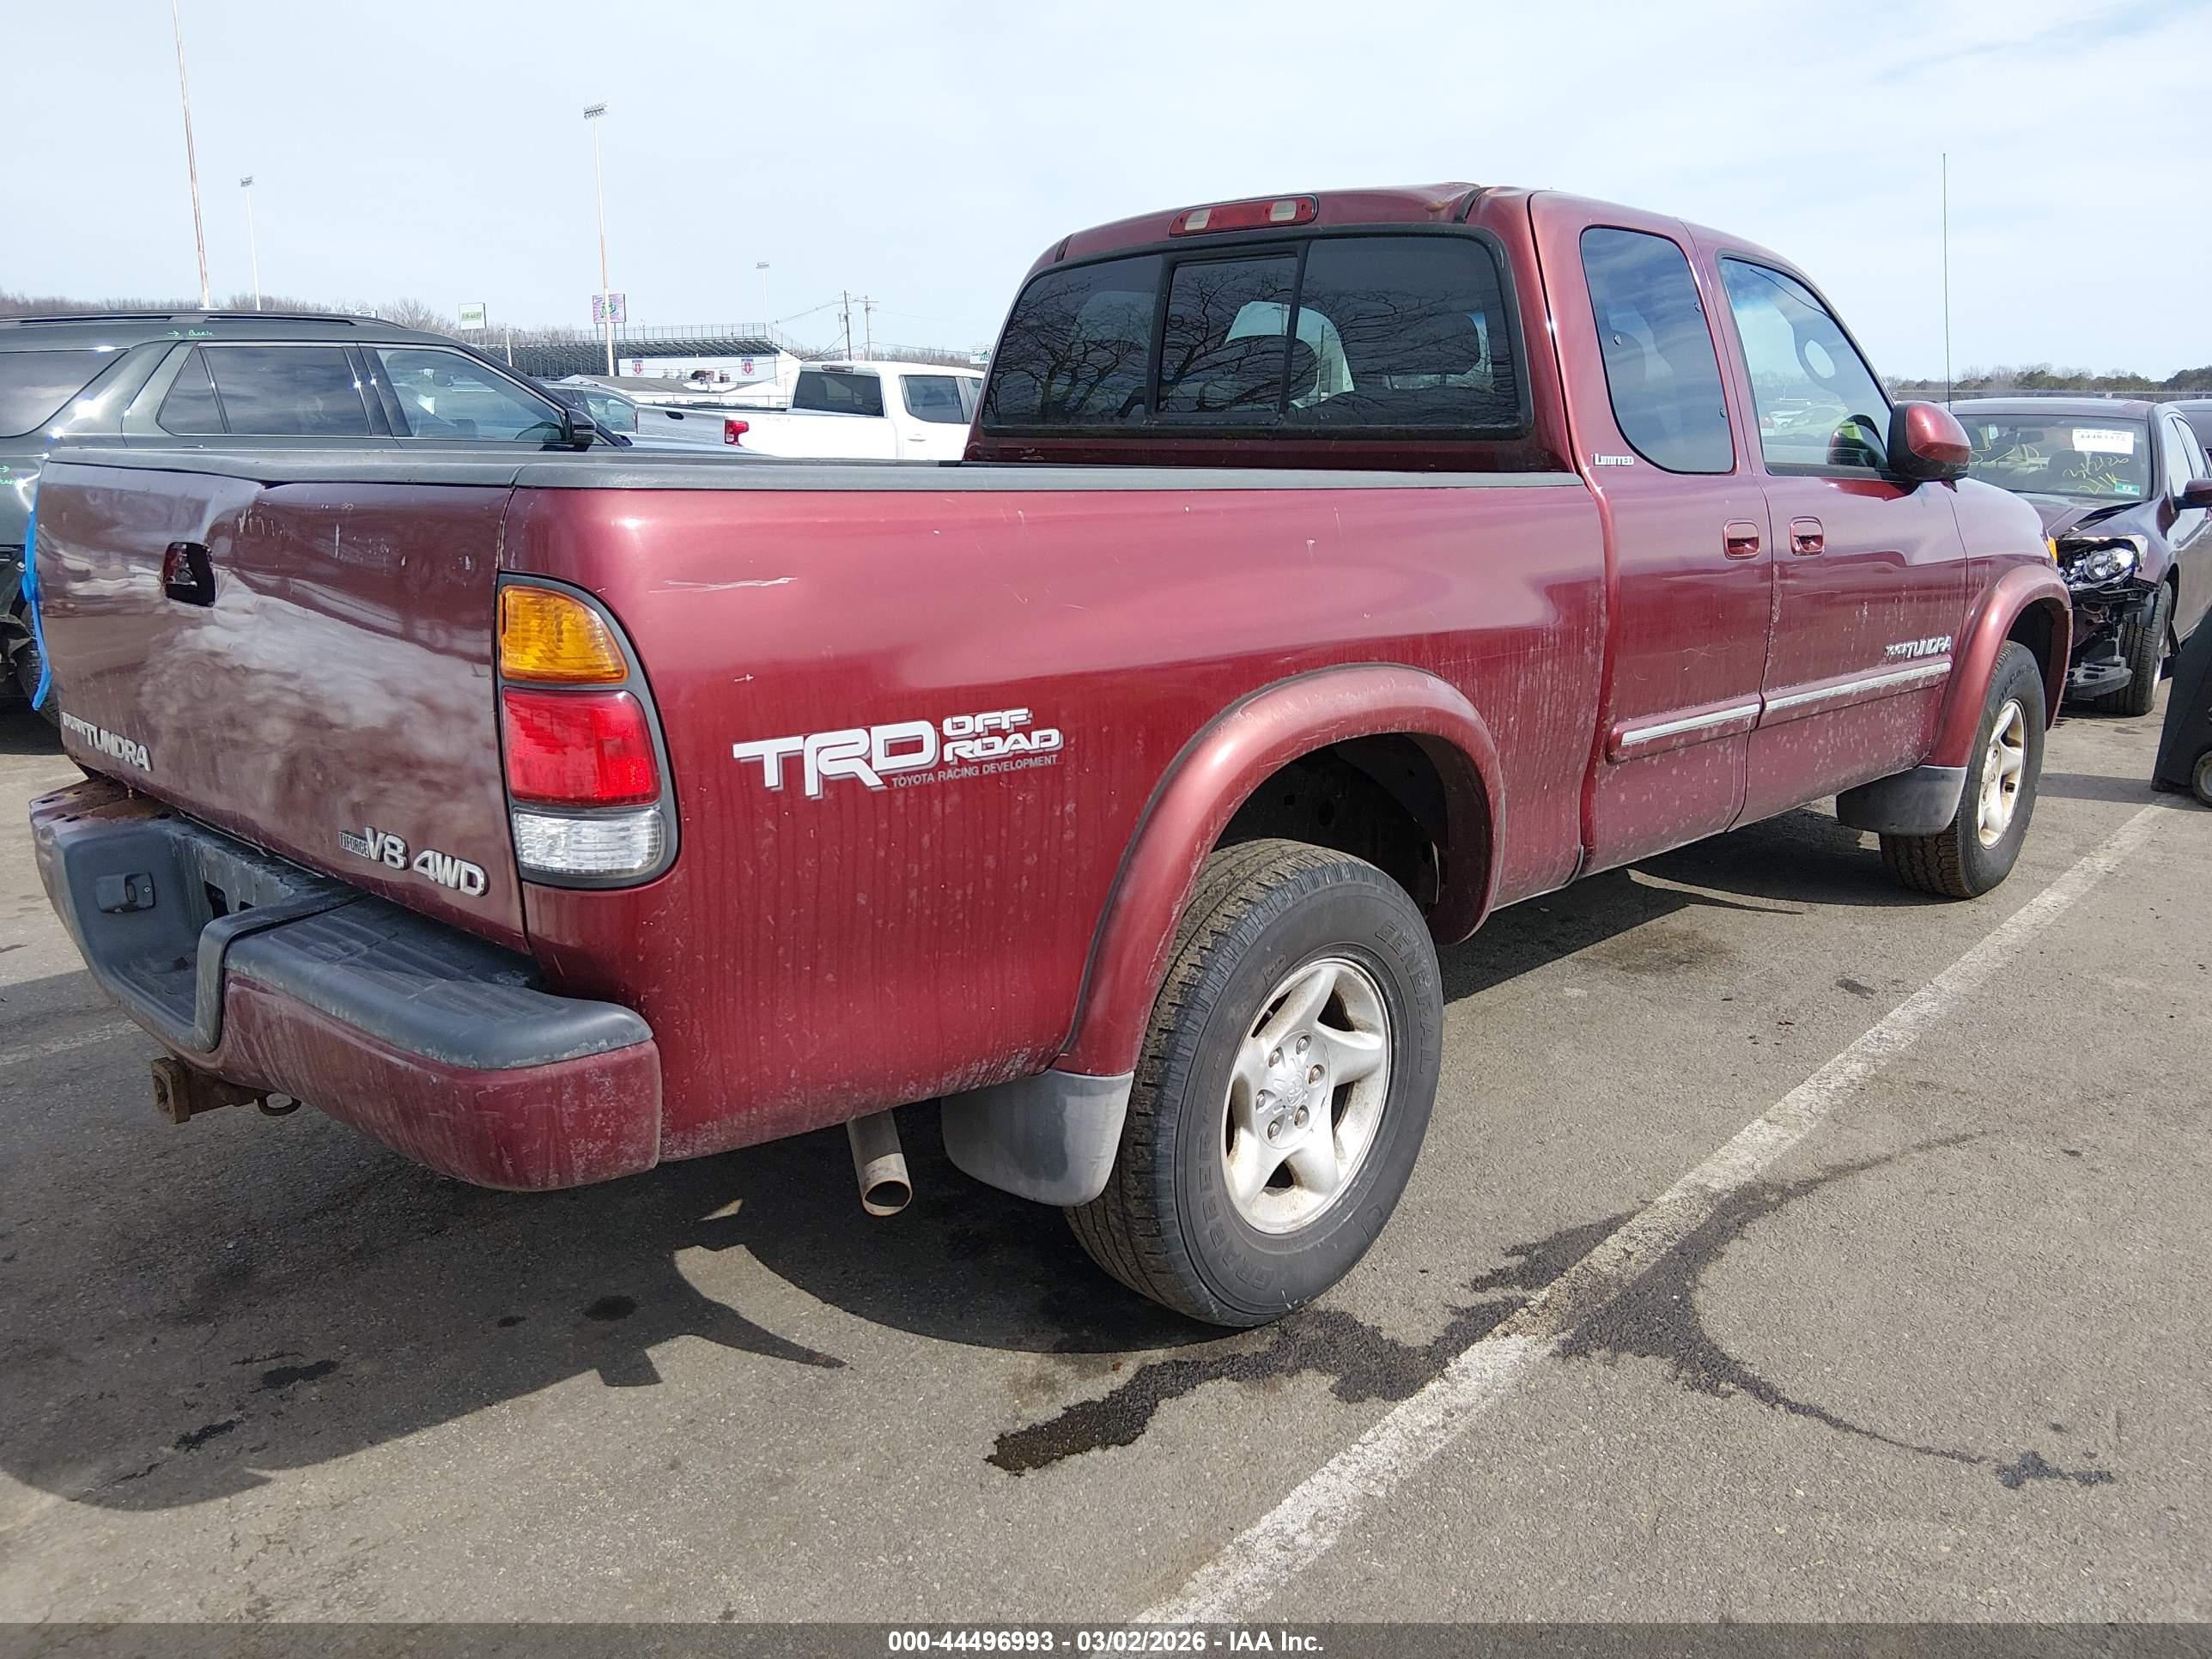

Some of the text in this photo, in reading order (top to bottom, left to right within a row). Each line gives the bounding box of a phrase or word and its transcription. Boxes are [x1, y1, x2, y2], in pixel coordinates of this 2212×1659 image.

[1905, 635, 1952, 659] TUNDRA
[942, 707, 1032, 741] OFF
[83, 721, 152, 772] TUNDRA
[732, 720, 940, 799] TRD
[943, 728, 1064, 766] ROAD
[891, 754, 1059, 788] TOYOTA RACING DEVELOPMENT
[364, 826, 407, 871] V8
[412, 848, 488, 897] 4WD
